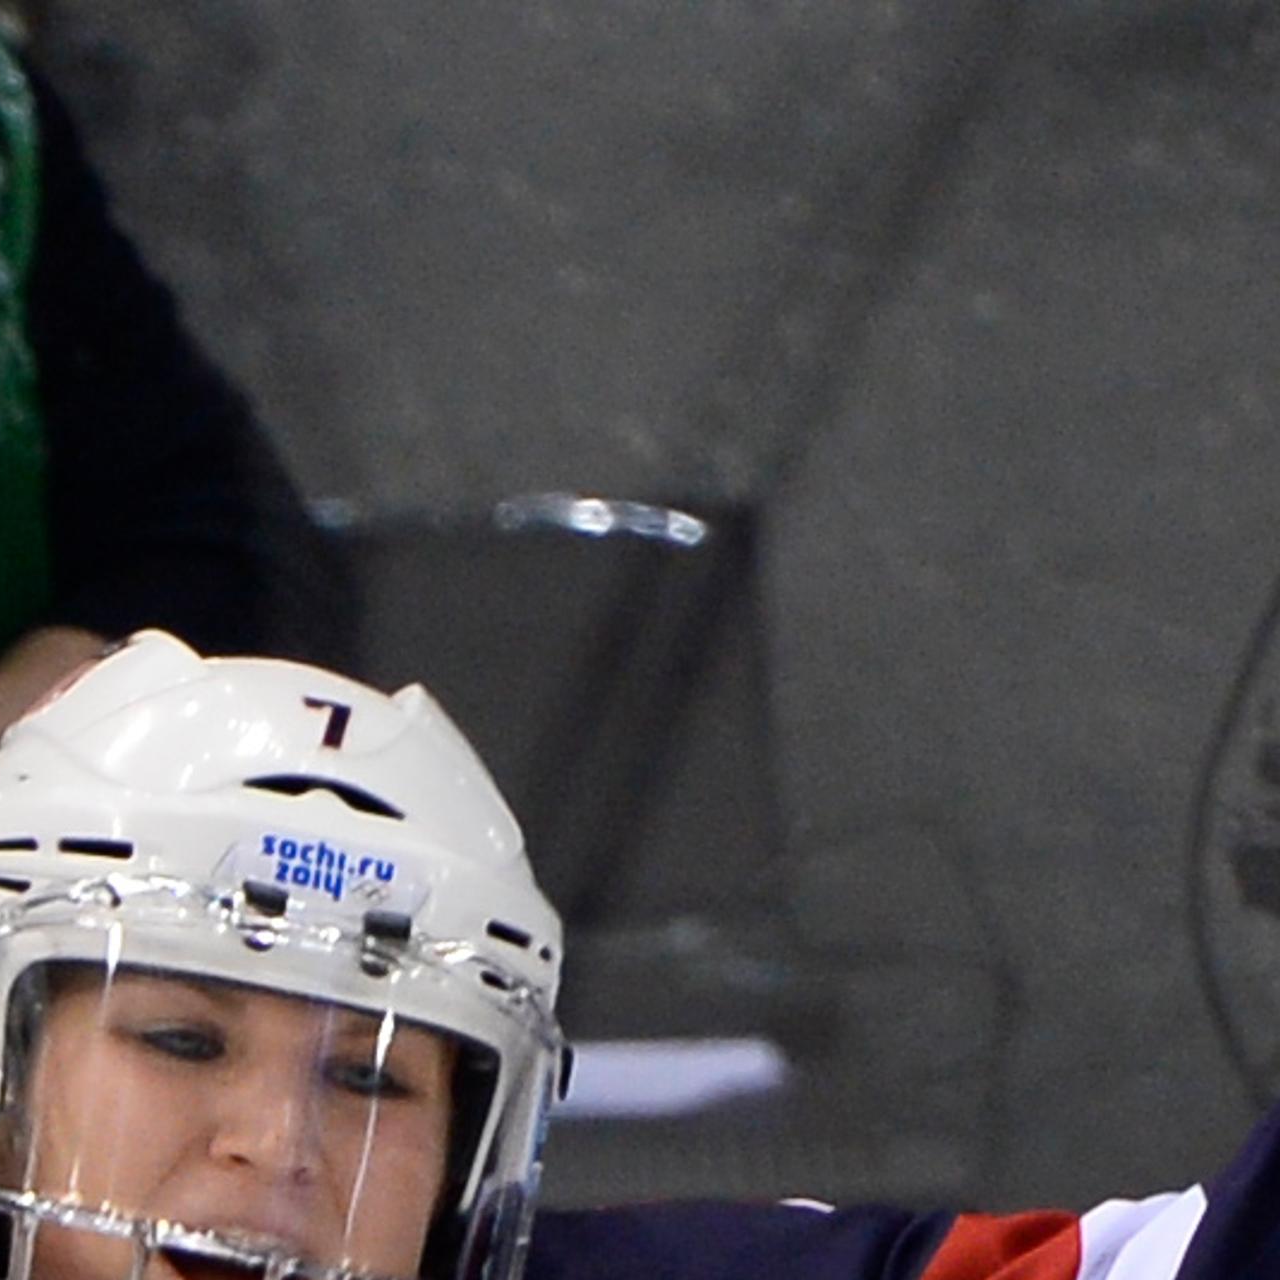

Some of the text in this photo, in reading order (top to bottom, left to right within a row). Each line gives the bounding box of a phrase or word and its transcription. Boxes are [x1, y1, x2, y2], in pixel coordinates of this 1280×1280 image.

[302, 695, 352, 750] 7
[262, 834, 395, 882] sochi.ru
[275, 859, 344, 901] 2014
